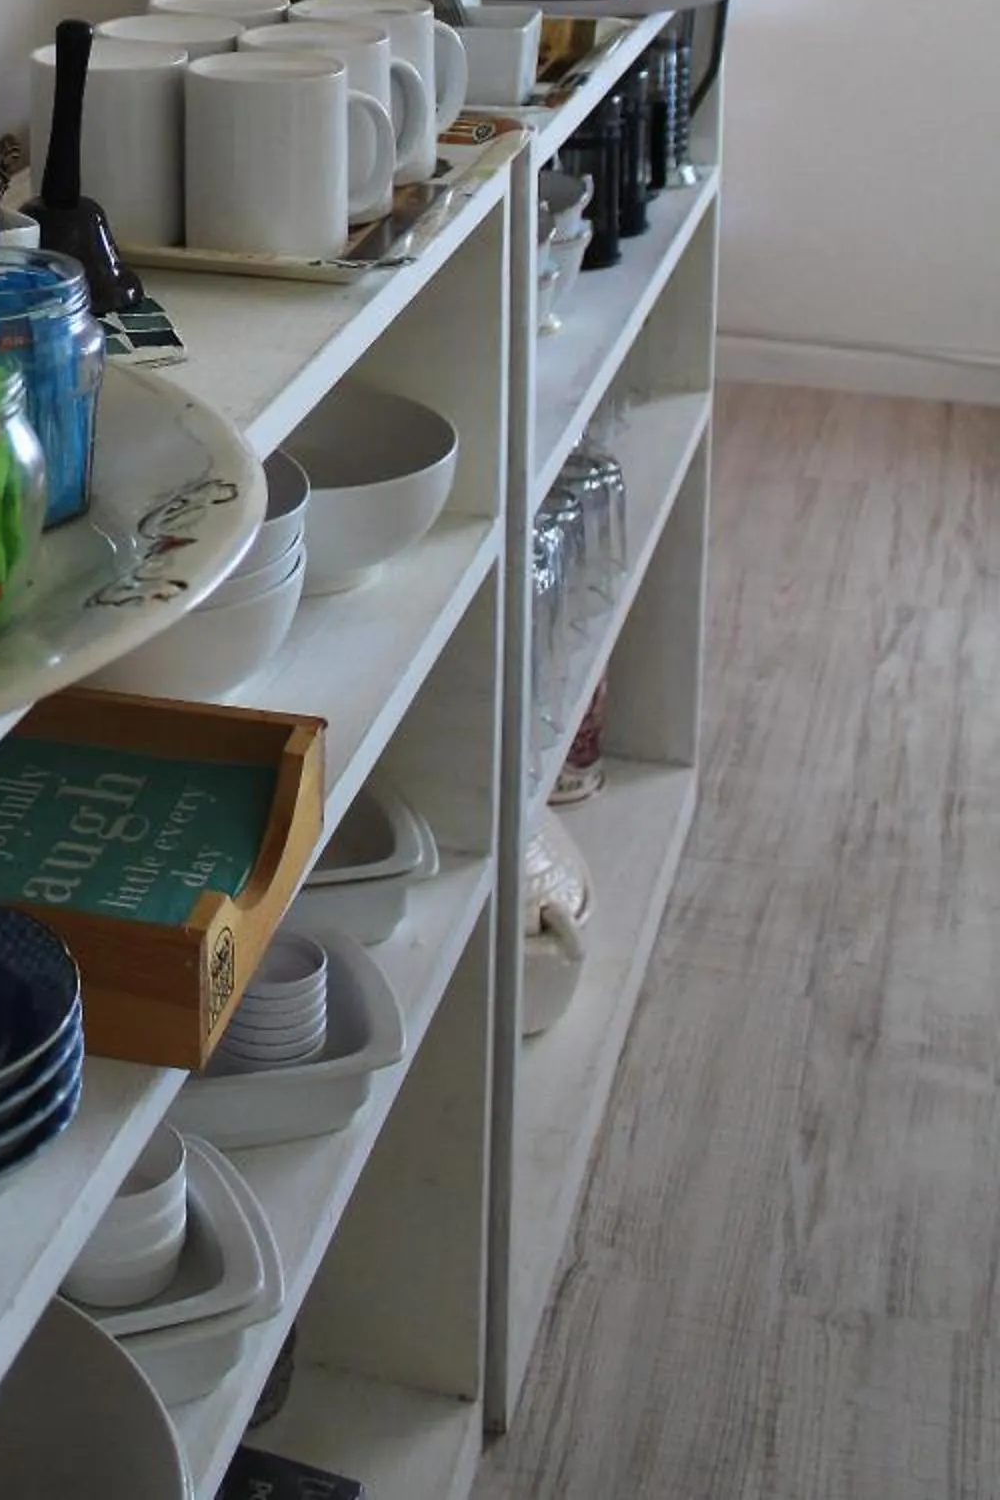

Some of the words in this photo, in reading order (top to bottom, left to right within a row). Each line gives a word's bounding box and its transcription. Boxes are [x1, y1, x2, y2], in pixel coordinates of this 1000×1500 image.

[22, 773, 150, 903] augh
[153, 784, 217, 852] every
[170, 845, 233, 888] day
